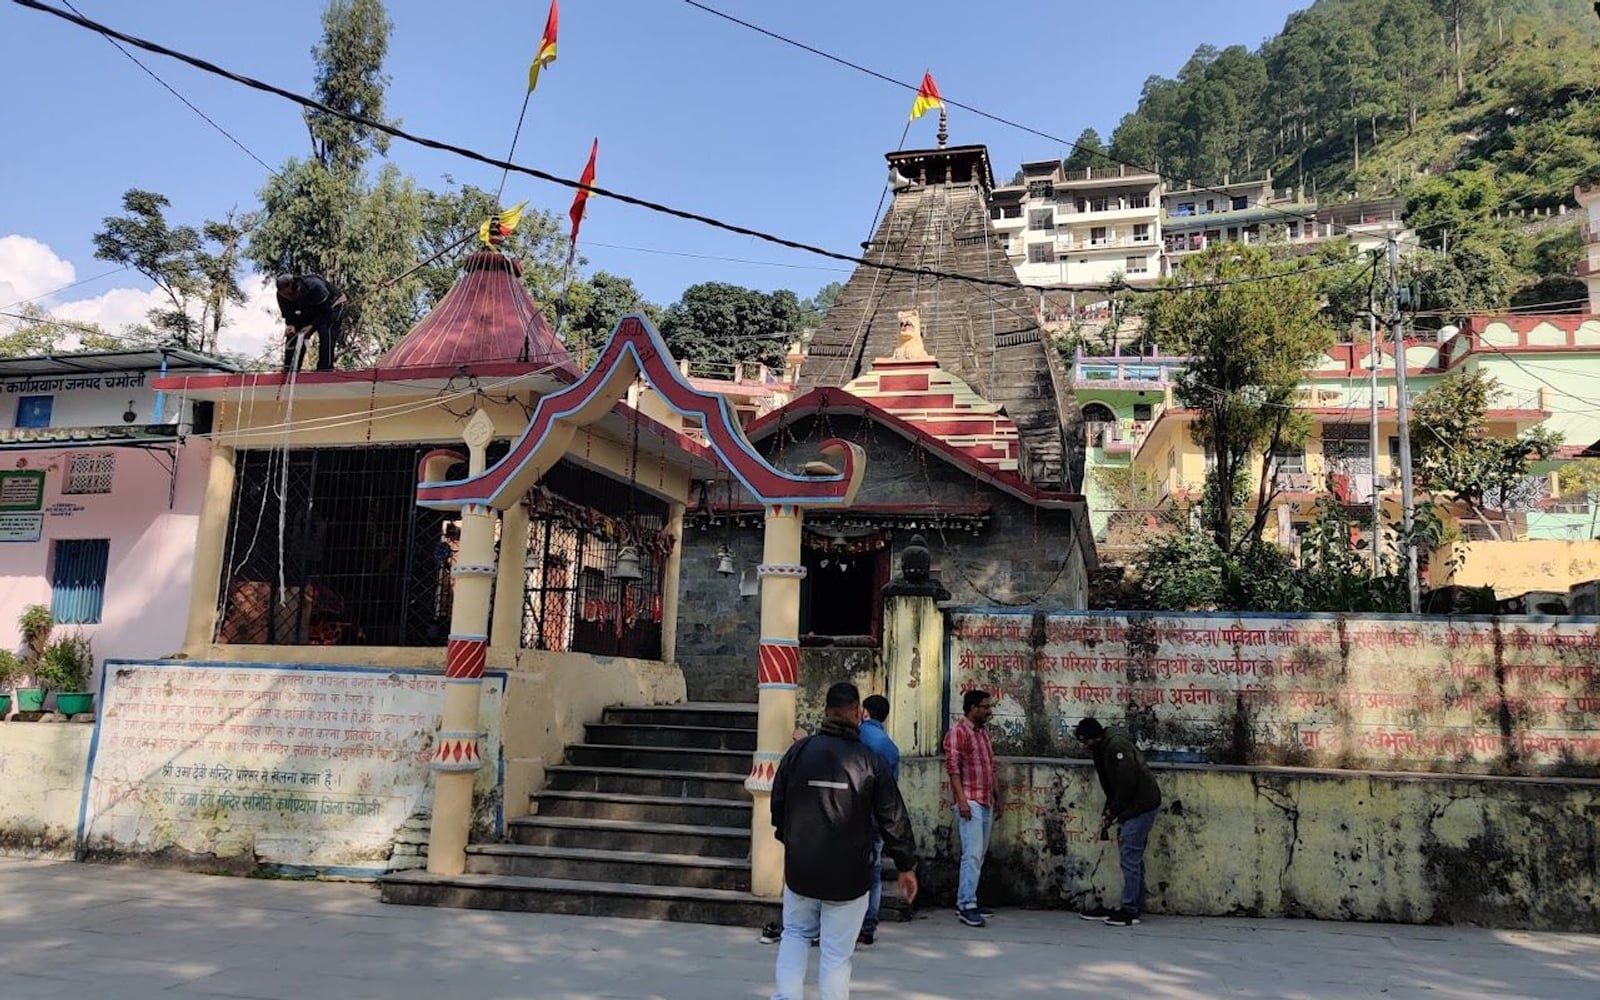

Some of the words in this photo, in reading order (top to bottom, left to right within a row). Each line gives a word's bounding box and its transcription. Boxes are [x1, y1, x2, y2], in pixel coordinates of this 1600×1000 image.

[6, 376, 63, 393] कर्णप्रयाग
[65, 378, 101, 390] जनपद
[104, 372, 146, 388] चमोली
[959, 648, 976, 670] श्री
[977, 654, 1002, 671] उमा
[1061, 650, 1098, 674] परिसर
[1070, 680, 1113, 704] परिसर
[1168, 683, 1213, 710] अर्चना
[161, 761, 175, 777] श्री
[175, 766, 190, 778] उमा
[193, 762, 208, 780] देवी
[209, 763, 233, 781] मन्दिर
[236, 765, 259, 783] परिसर
[271, 767, 297, 784] खेलना
[299, 771, 321, 785] मना
[163, 787, 176, 805] श्री
[179, 793, 198, 807] उमा
